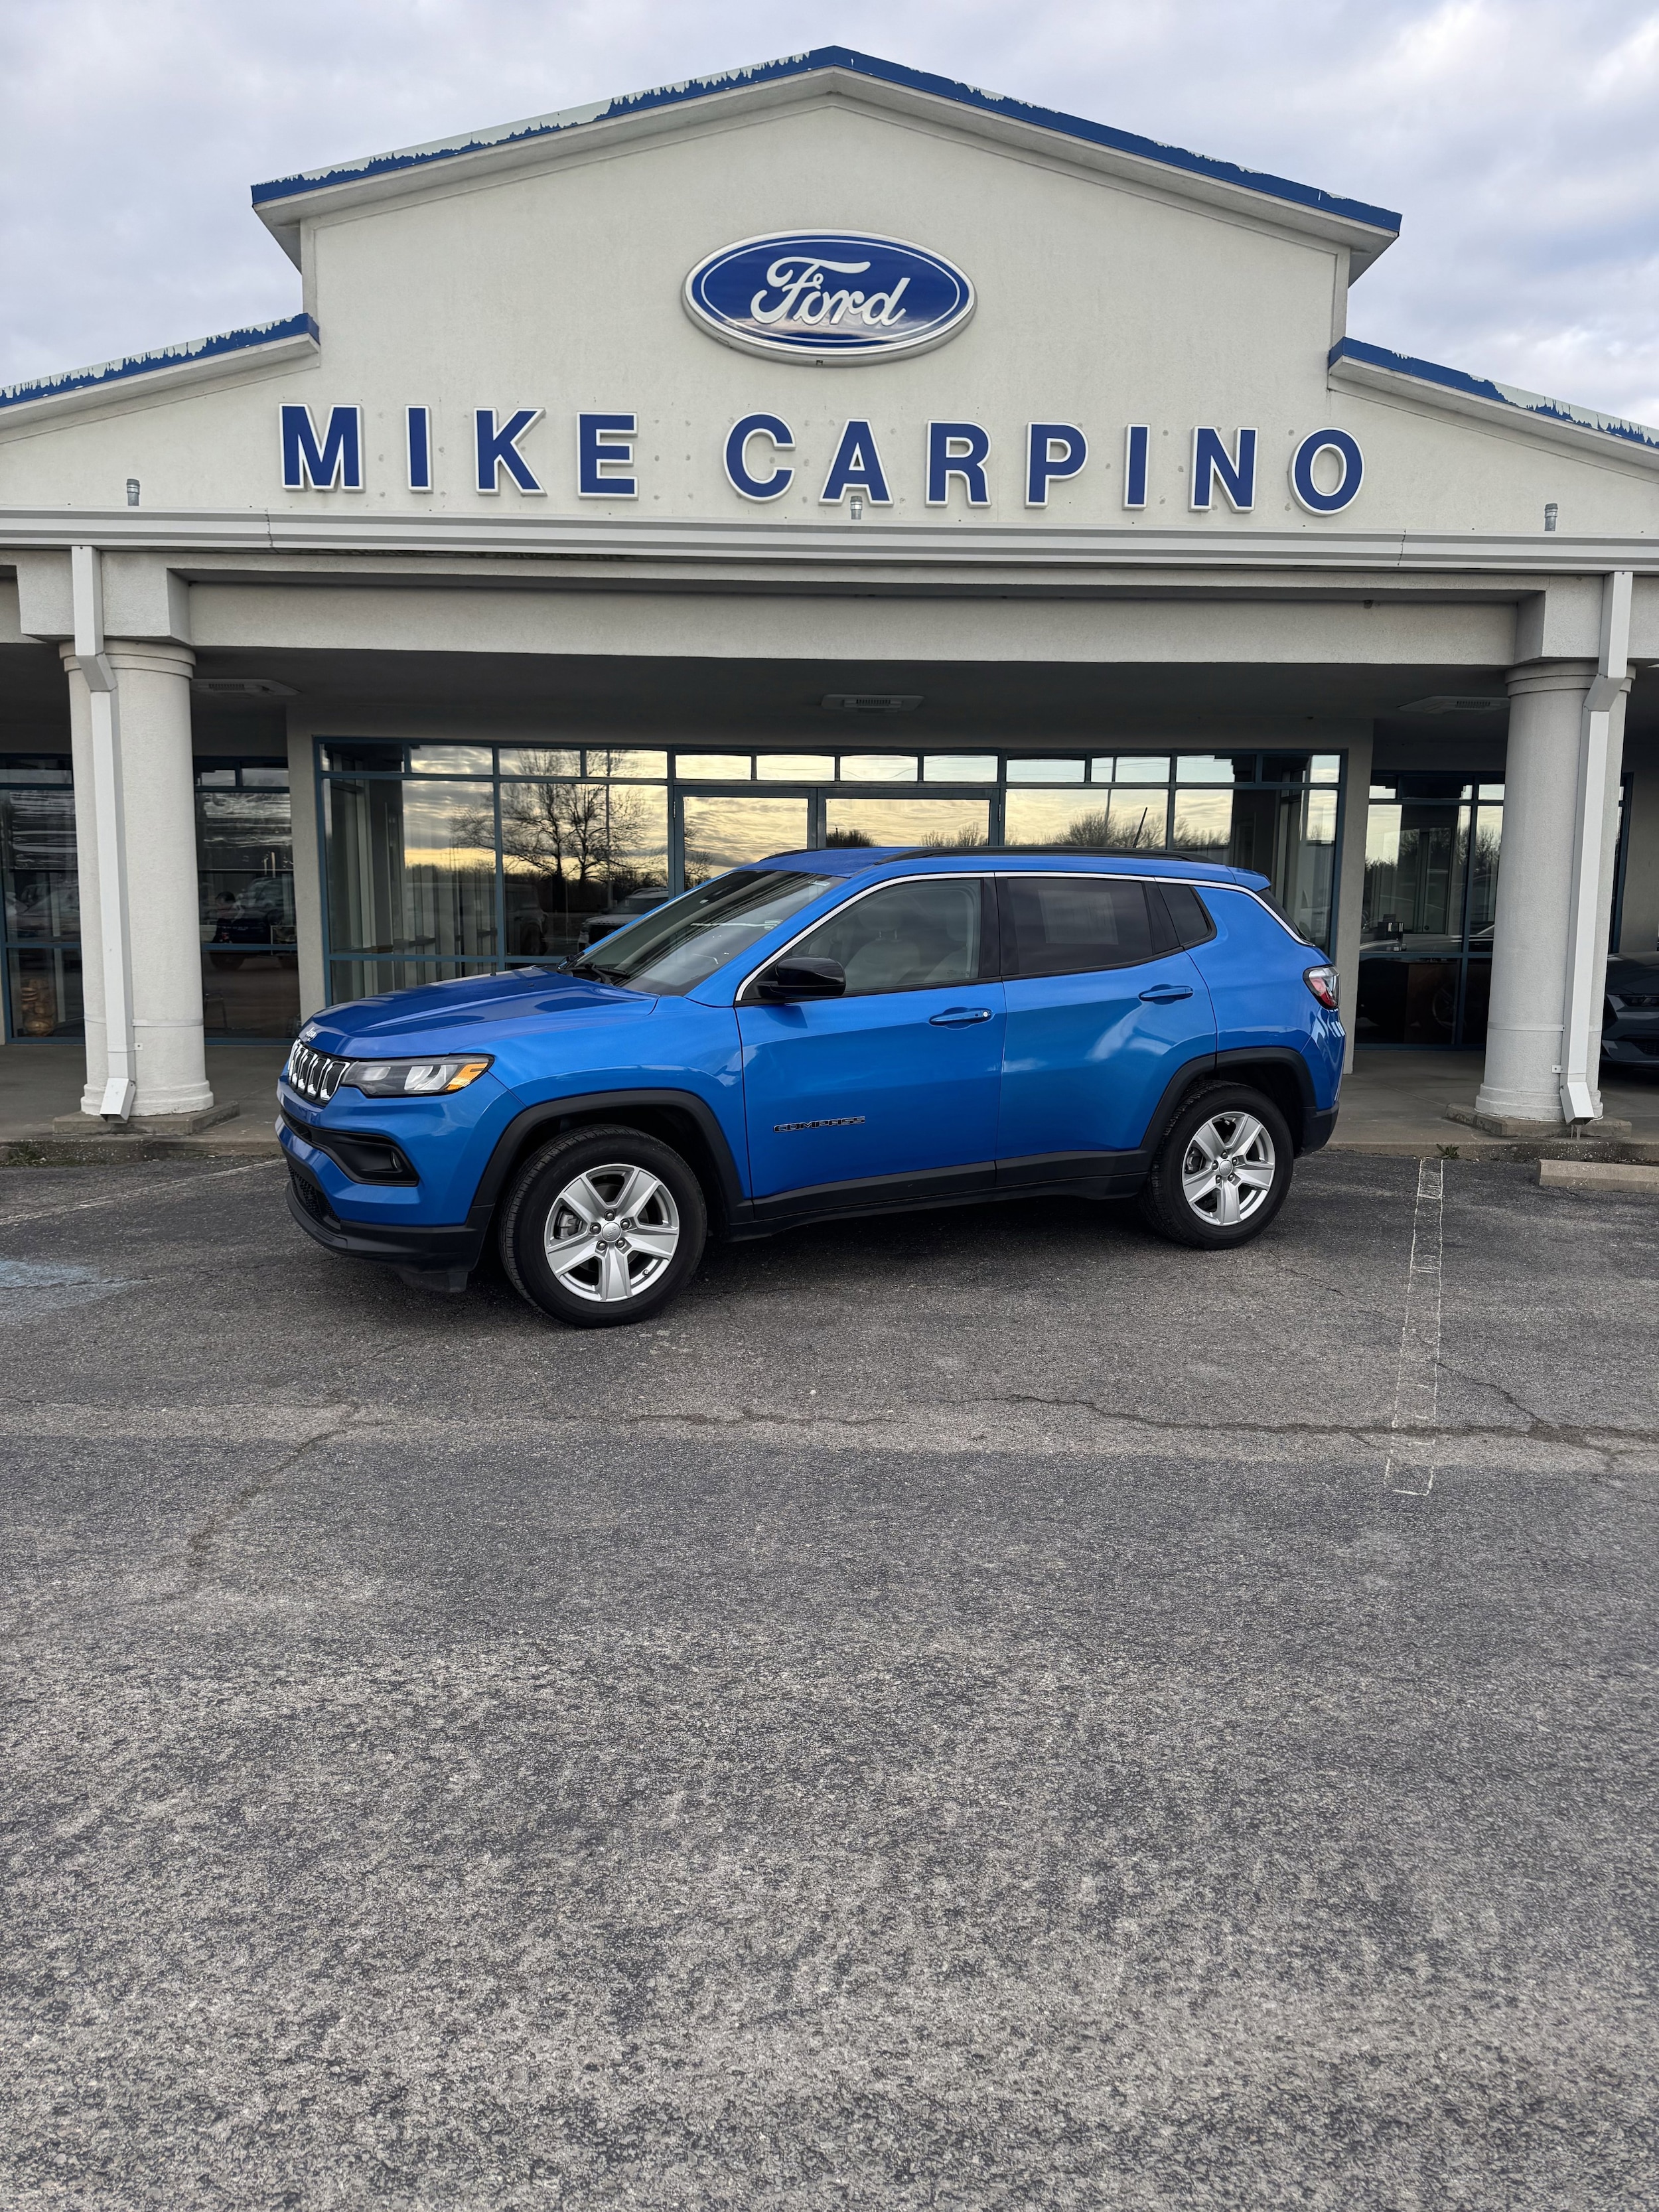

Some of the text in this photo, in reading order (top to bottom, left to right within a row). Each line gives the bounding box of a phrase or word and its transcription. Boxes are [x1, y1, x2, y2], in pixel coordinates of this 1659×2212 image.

[750, 256, 911, 327] Ford
[279, 402, 1366, 517] MIKE CARPINO
[773, 1116, 865, 1133] COMPASS
